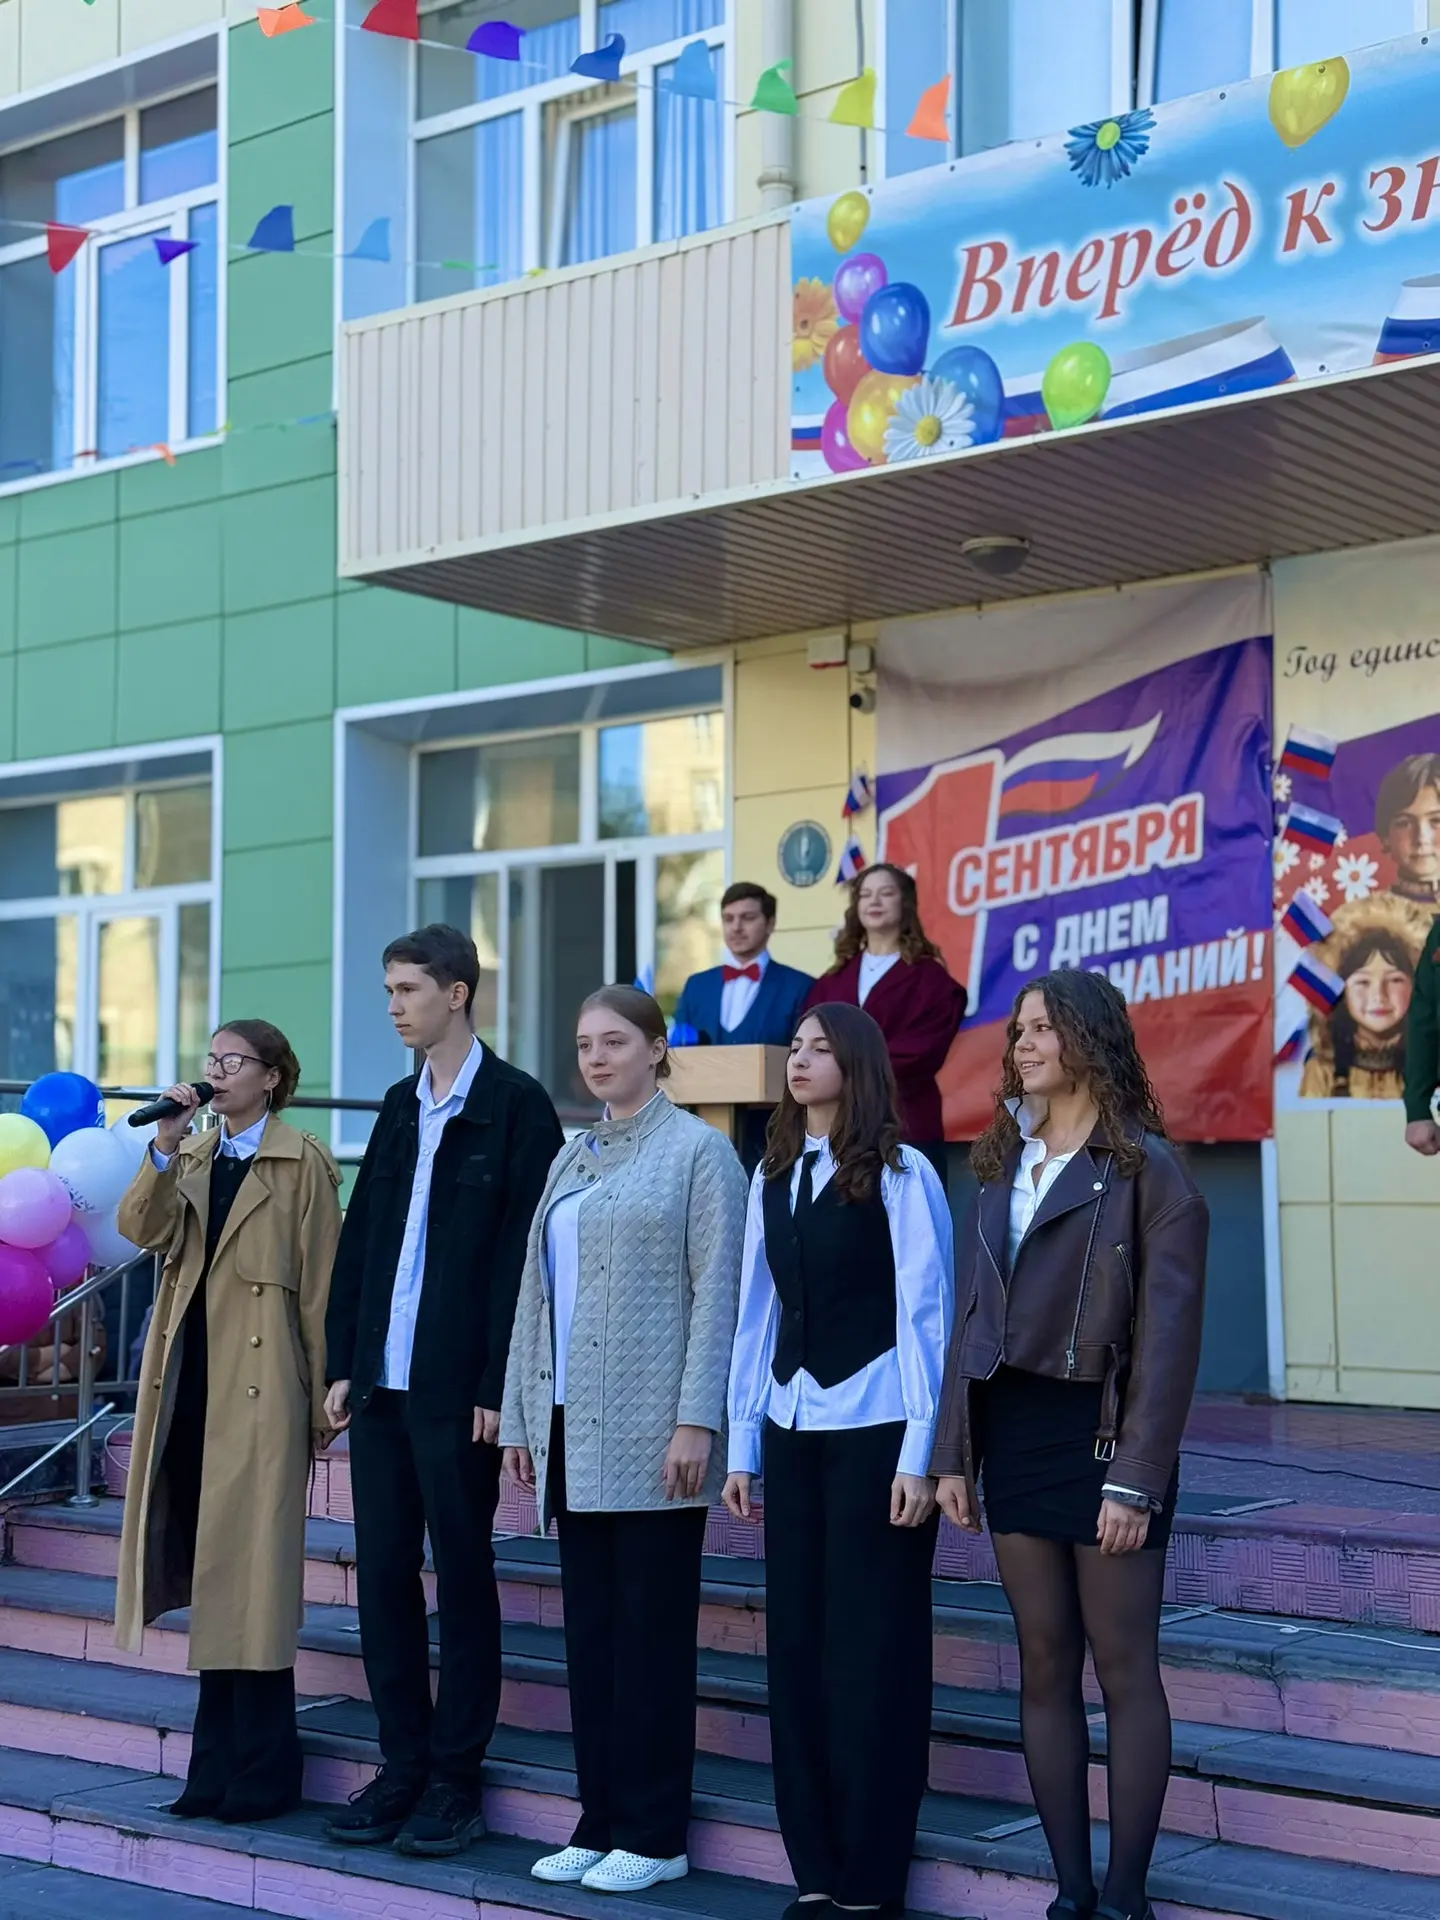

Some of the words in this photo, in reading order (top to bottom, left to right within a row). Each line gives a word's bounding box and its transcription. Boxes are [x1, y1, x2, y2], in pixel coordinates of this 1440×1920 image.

[943, 180, 1253, 328] Вперёд
[1282, 182, 1336, 253] к
[1283, 646, 1337, 683] Год
[1350, 637, 1440, 678] единс
[876, 749, 1004, 1017] 1
[950, 795, 1204, 916] СЕНТЯБРЯ
[1012, 923, 1041, 972] С
[1050, 894, 1169, 971] ДНЕМ
[1088, 926, 1265, 1006] НАНИЙ!
